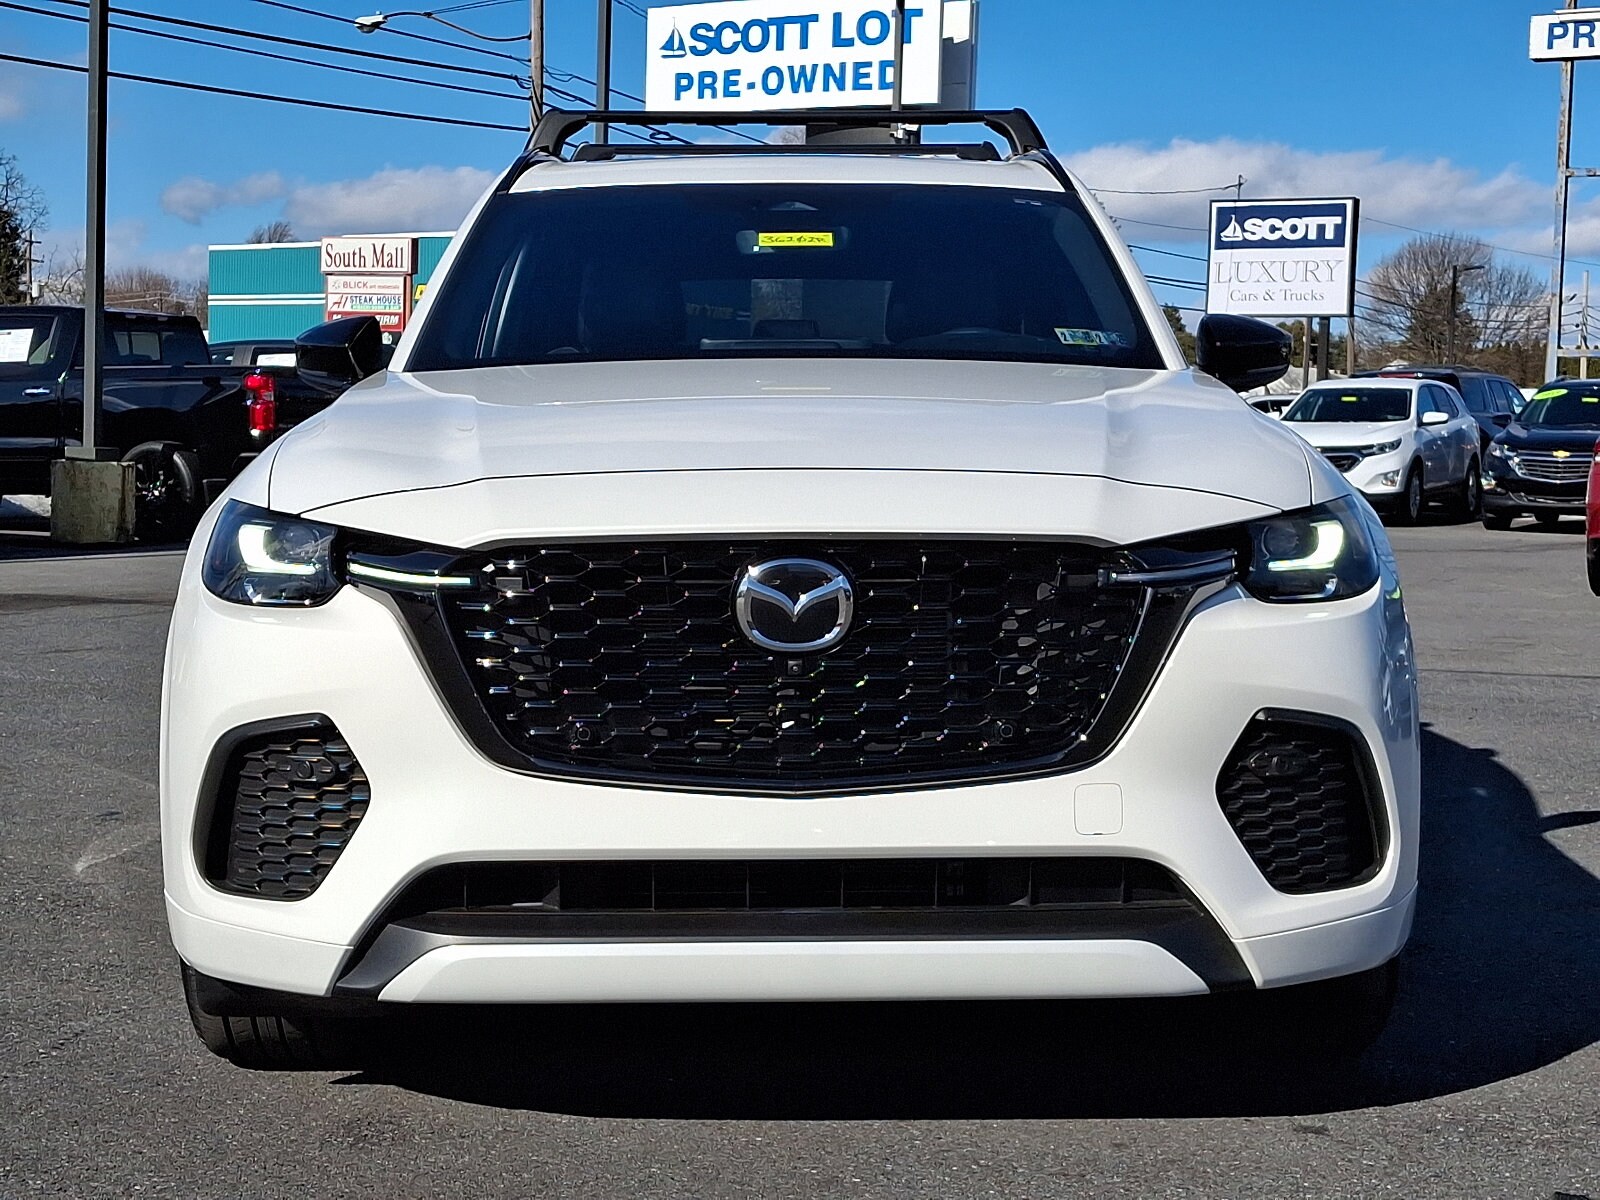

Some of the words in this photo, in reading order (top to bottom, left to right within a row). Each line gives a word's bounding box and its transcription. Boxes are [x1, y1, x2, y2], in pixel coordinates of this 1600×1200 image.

[688, 13, 819, 57] SCOTT
[832, 8, 923, 48] LOT
[674, 60, 896, 101] PRE-OWNED
[1242, 216, 1343, 241] SCOTT
[325, 243, 366, 268] South
[371, 243, 404, 268] Mall
[1213, 259, 1344, 284] LUXURY
[342, 281, 369, 289] BLICK
[1230, 288, 1259, 301] Cars
[1262, 289, 1276, 301] &
[1279, 289, 1325, 301] Trucks
[350, 295, 374, 304] STEAK
[376, 295, 401, 304] HOUSE
